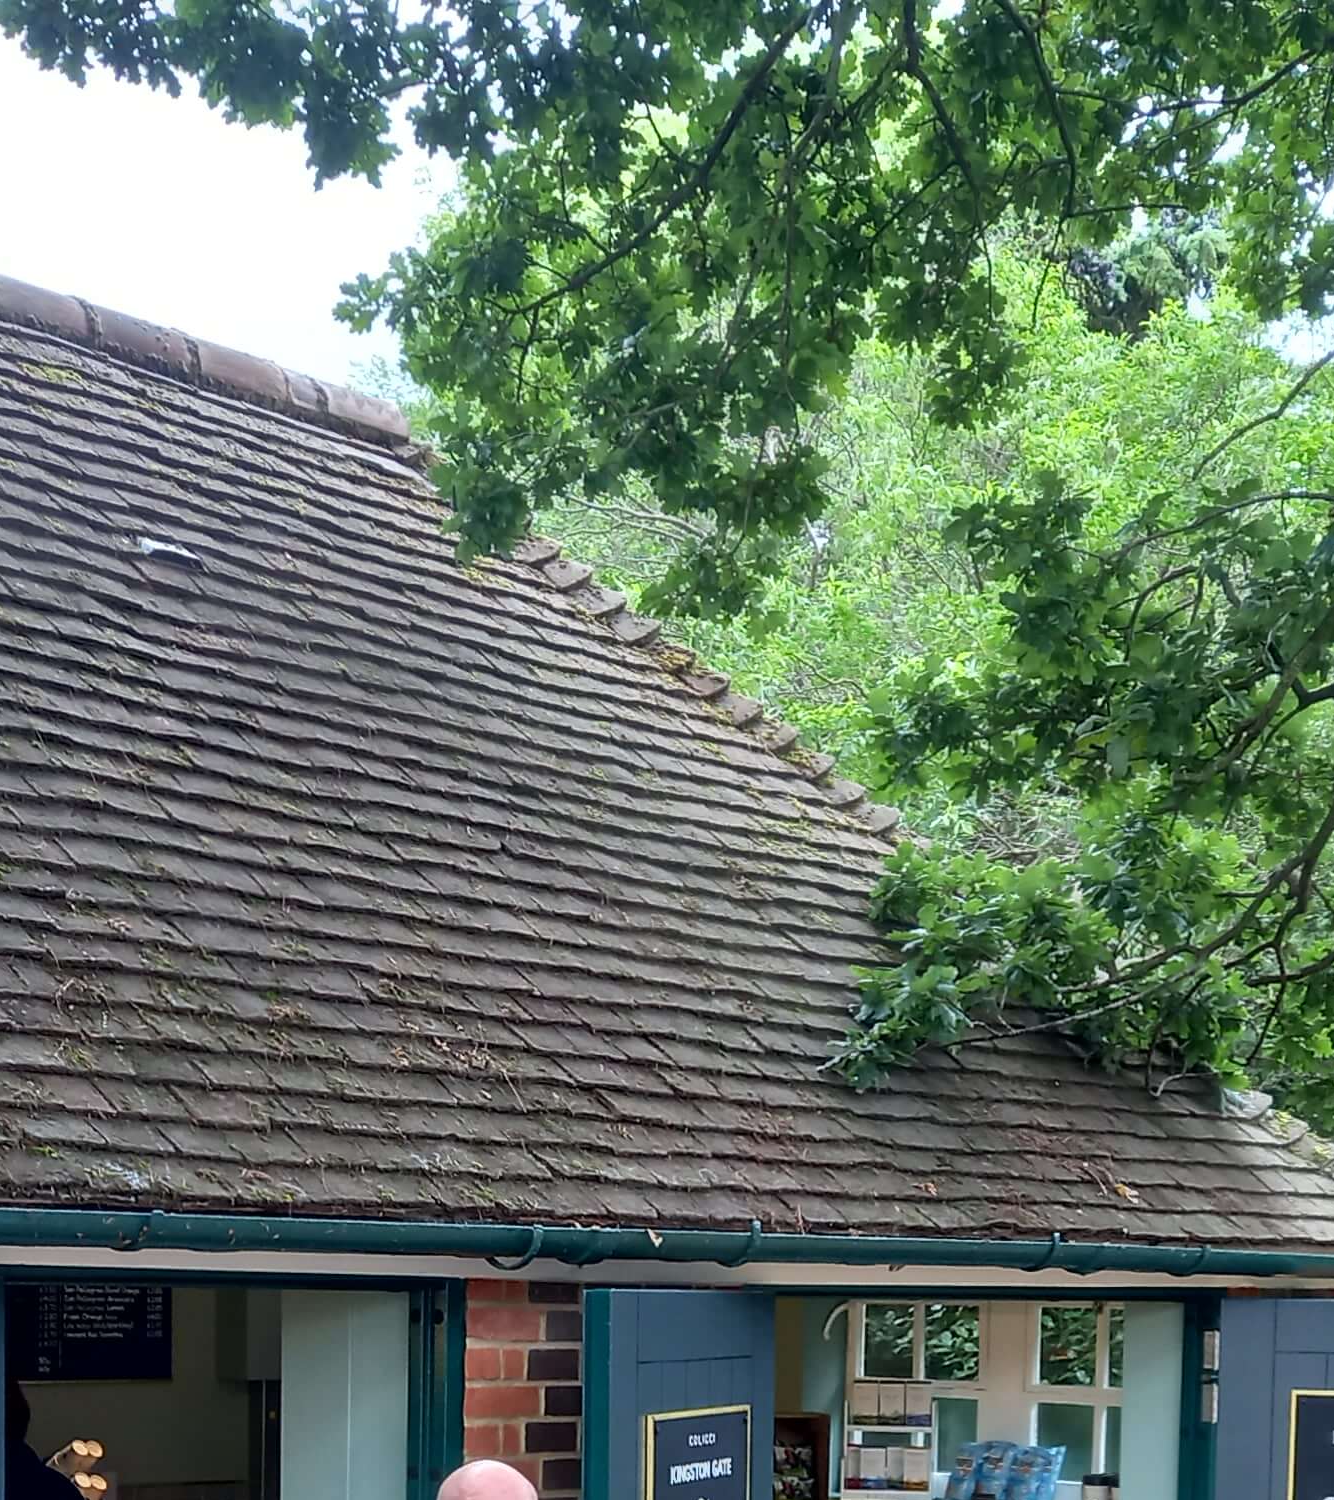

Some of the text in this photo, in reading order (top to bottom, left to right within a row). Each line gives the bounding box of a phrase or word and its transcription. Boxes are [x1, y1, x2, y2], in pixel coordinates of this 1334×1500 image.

[689, 1433, 716, 1447] COLICCI
[670, 1457, 732, 1485] KINGSTON GATE
